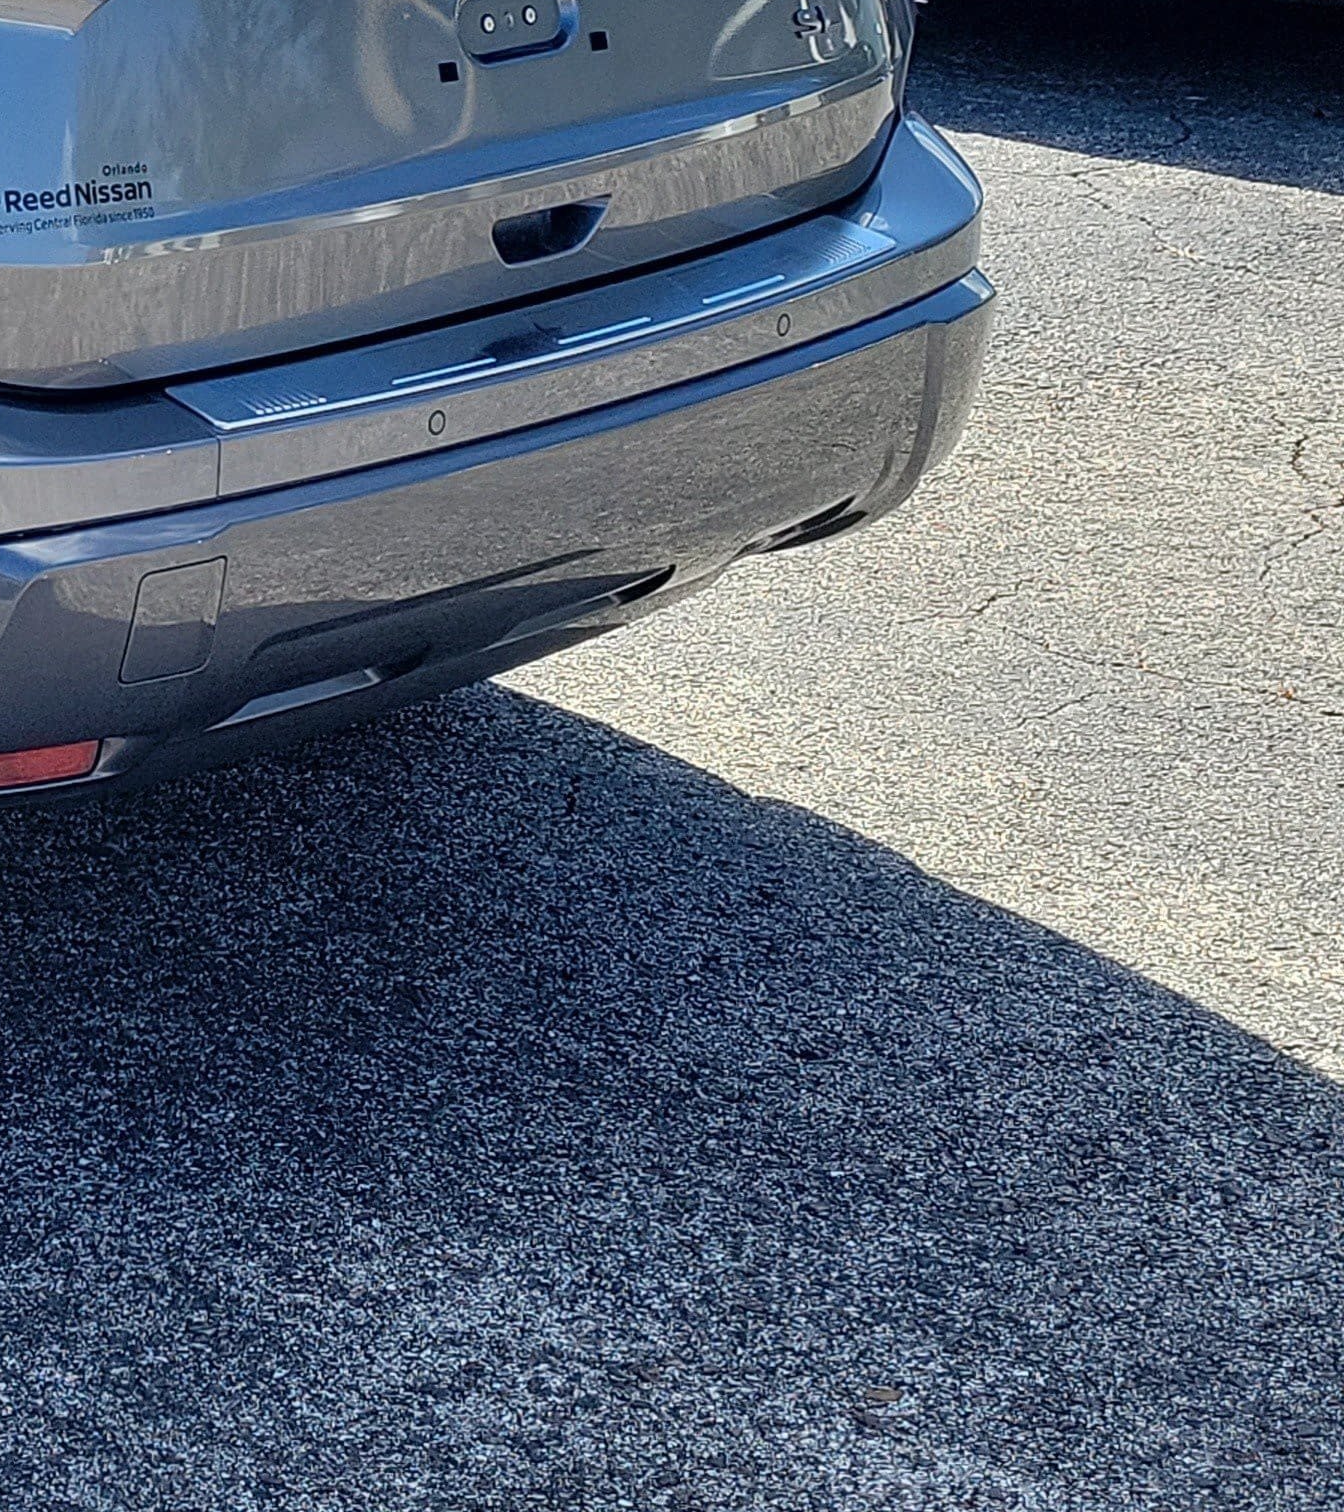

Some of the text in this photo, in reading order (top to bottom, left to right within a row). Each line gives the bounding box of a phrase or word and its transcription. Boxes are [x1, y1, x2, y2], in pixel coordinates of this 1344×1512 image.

[102, 162, 148, 177] Orlando
[4, 179, 152, 213] Reed Nissan
[34, 216, 72, 232] Central
[73, 212, 107, 226] Florida
[109, 210, 132, 223] since
